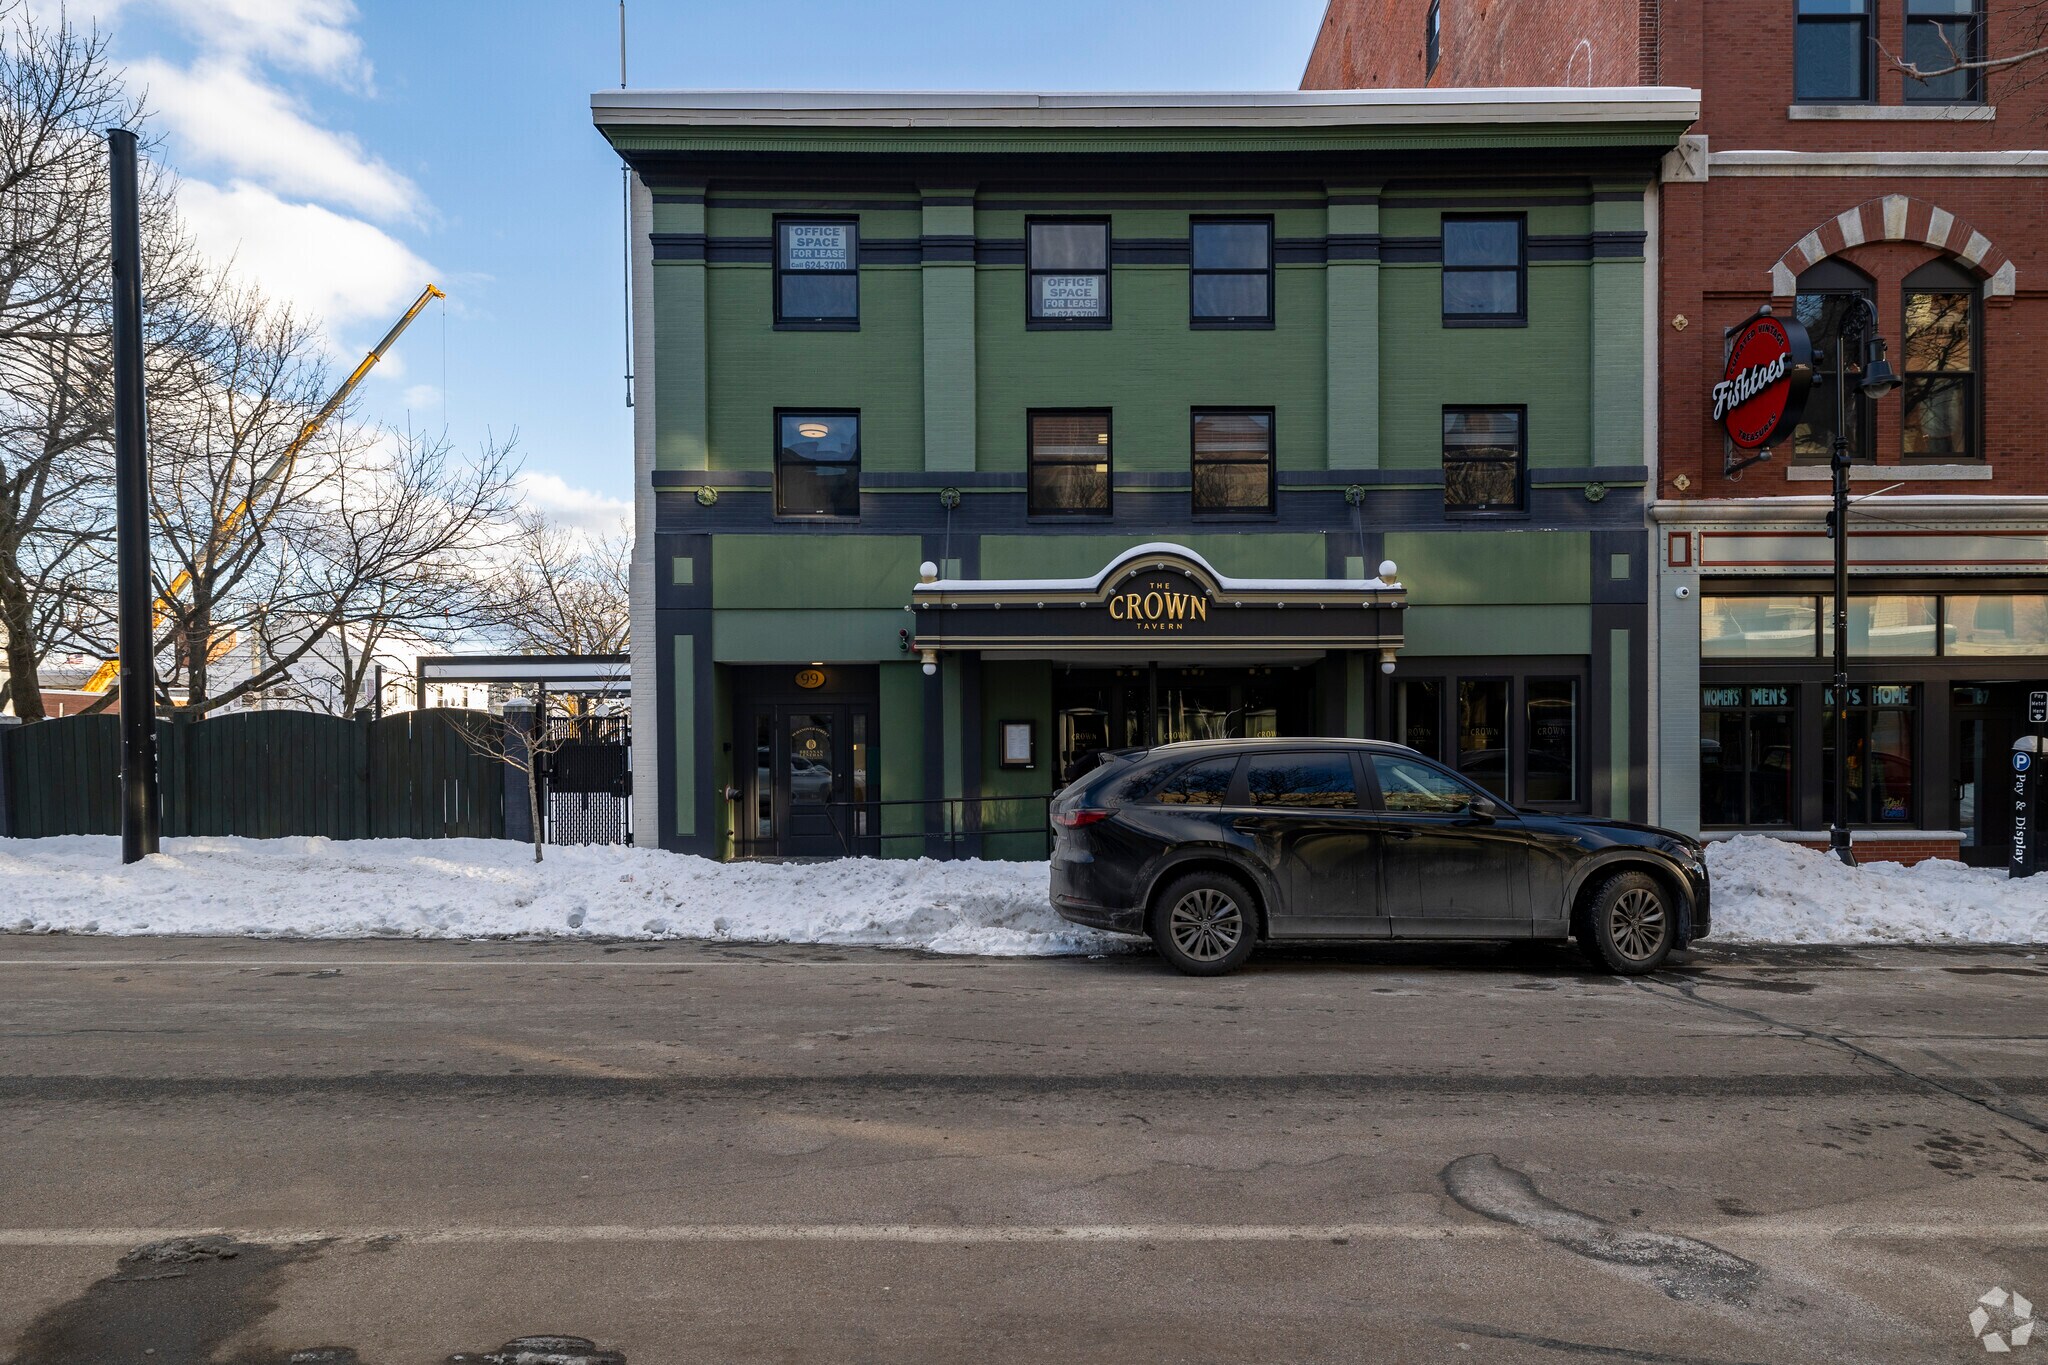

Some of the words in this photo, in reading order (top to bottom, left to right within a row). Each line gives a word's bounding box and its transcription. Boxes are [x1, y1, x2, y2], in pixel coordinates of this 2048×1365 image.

[794, 227, 841, 236] OFFICE
[796, 238, 839, 247] SPACE
[792, 249, 812, 258] FOR
[814, 249, 845, 258] LEASE
[804, 260, 846, 269] 624-3700
[1047, 278, 1093, 287] OFFICE
[1049, 288, 1092, 297] SPACE
[1045, 299, 1065, 308] FOR
[1067, 299, 1097, 308] LEASE
[1730, 329, 1756, 375] CURATED
[1757, 323, 1785, 347] VINTAGE
[1712, 351, 1786, 421] Fishtoes
[1738, 412, 1777, 441] TREASURES
[1149, 582, 1170, 590] THE
[1109, 591, 1207, 622] CROWN
[801, 673, 818, 685] 99
[1703, 689, 1740, 706] WOMEN'S
[1751, 687, 1788, 706] MEN'S
[1872, 687, 1909, 705] HOME
[1976, 689, 1990, 705] 87
[1470, 727, 1500, 737] CROWN
[1537, 726, 1566, 737] CROWN
[2013, 773, 2027, 796] Pay
[2015, 800, 2027, 811] &
[2012, 816, 2027, 865] Display
